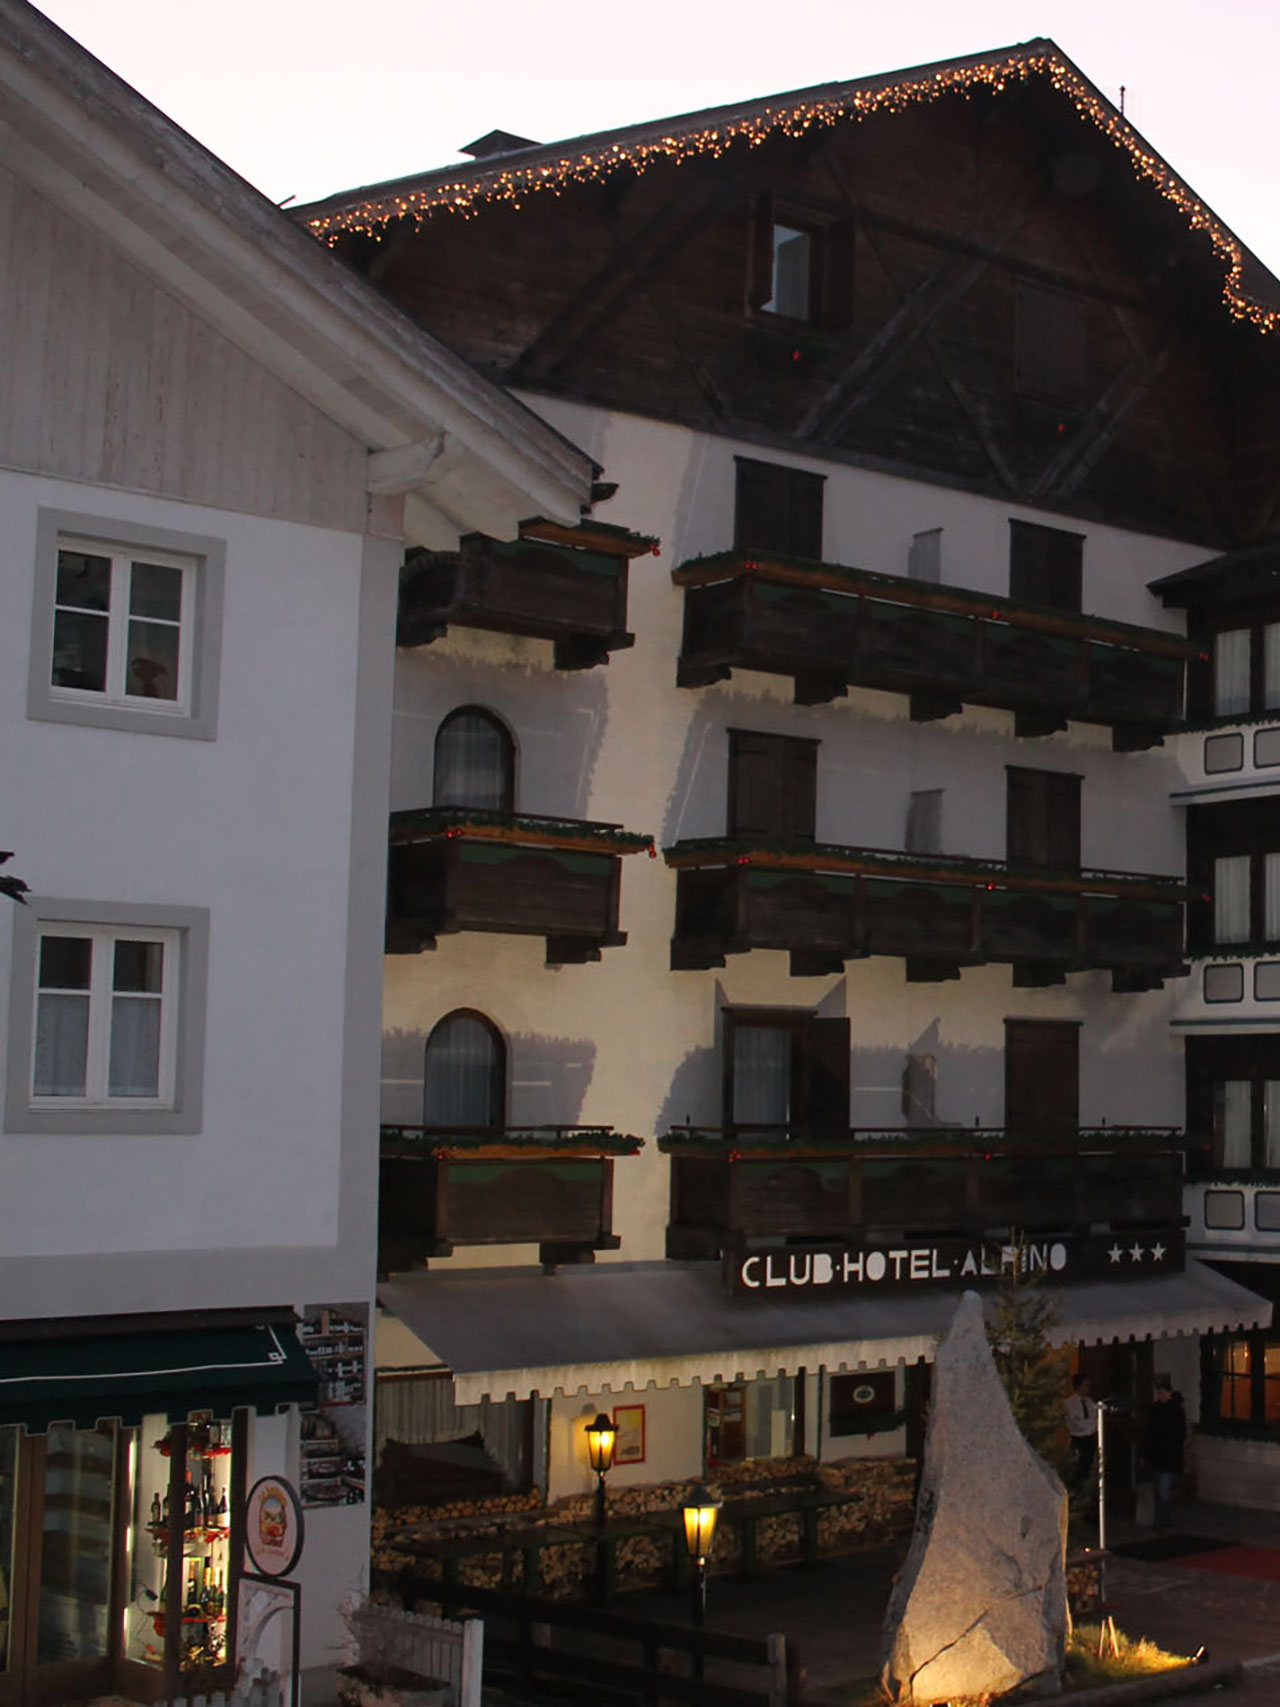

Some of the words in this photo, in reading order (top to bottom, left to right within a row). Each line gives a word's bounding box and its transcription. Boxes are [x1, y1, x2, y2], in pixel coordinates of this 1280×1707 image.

[741, 1254, 834, 1288] CLUB
[843, 1248, 951, 1283] HOTEL
[960, 1242, 1067, 1277] ALPINO
